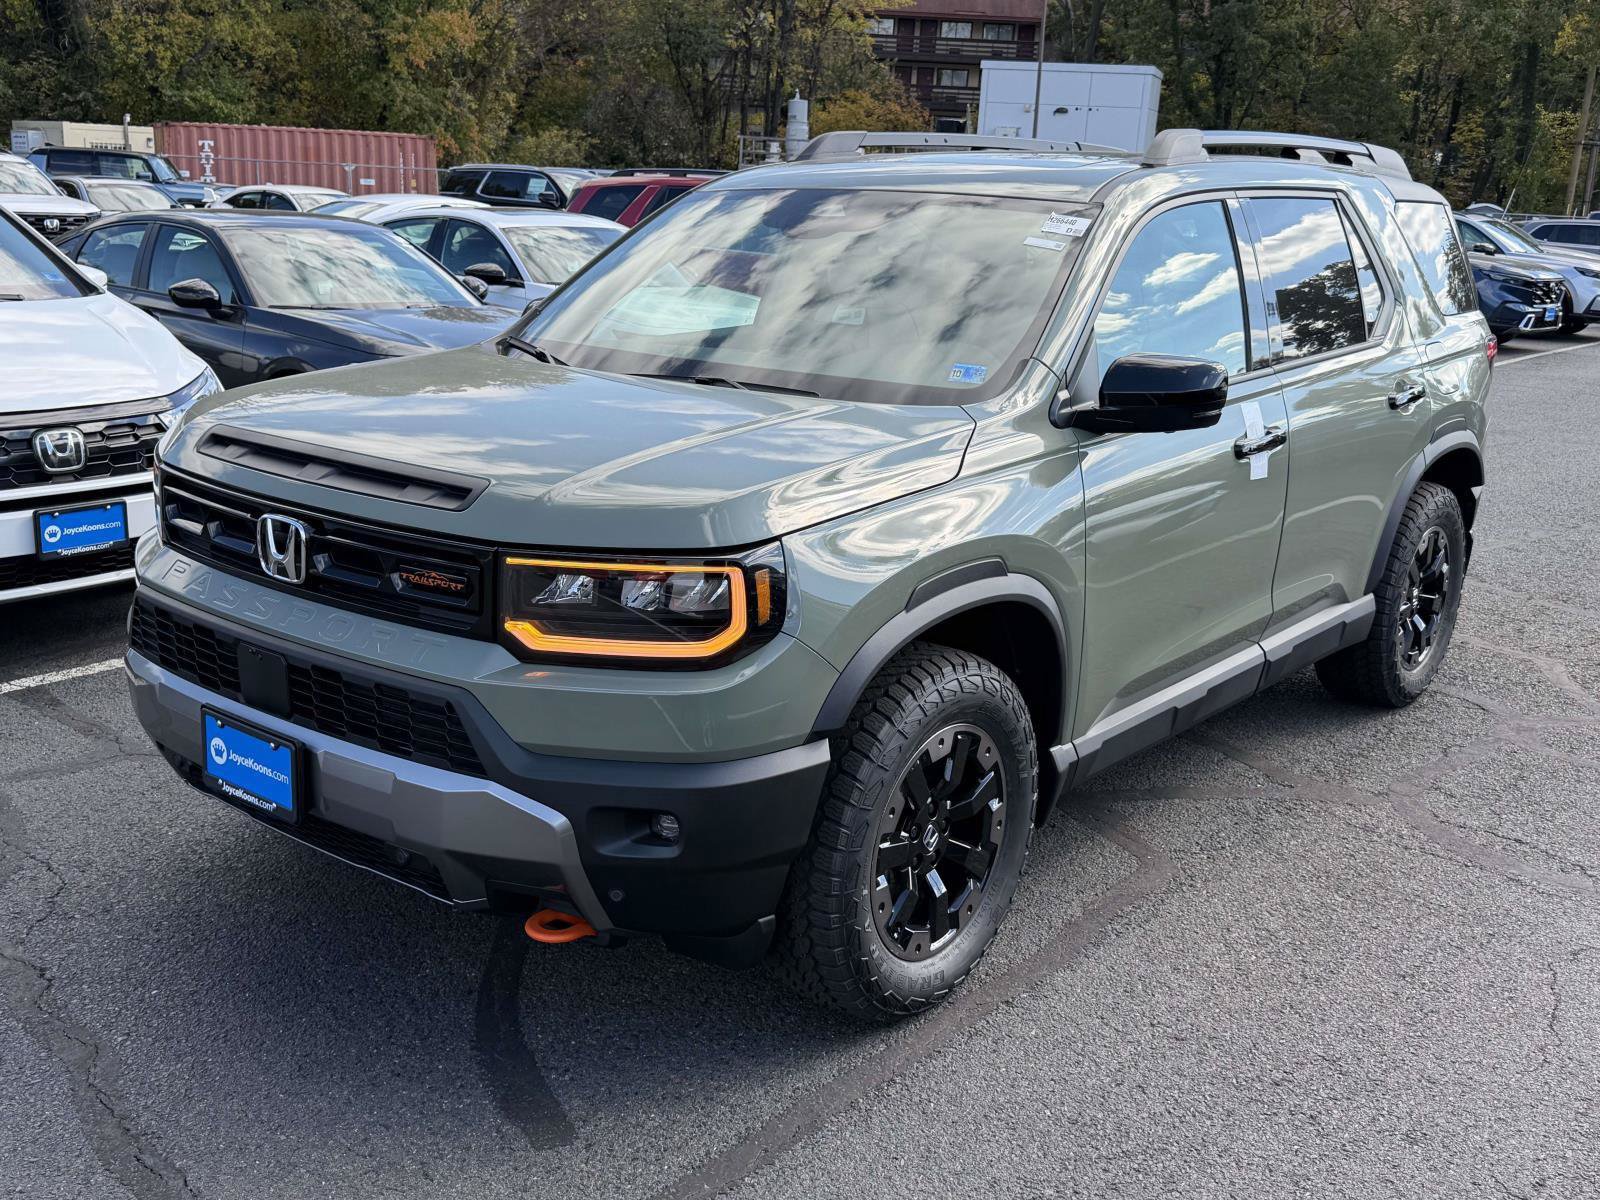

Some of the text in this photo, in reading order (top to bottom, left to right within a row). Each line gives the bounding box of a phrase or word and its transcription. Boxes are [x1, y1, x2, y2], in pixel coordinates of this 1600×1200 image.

[62, 520, 121, 535] JoyceKoons.com
[60, 543, 110, 556] JoyceKoons.com
[400, 572, 464, 591] TRAILSPORT
[162, 559, 448, 663] PASSPORT
[229, 749, 289, 785] JoyceKoons.com
[222, 781, 273, 812] JoyceKoons.com
